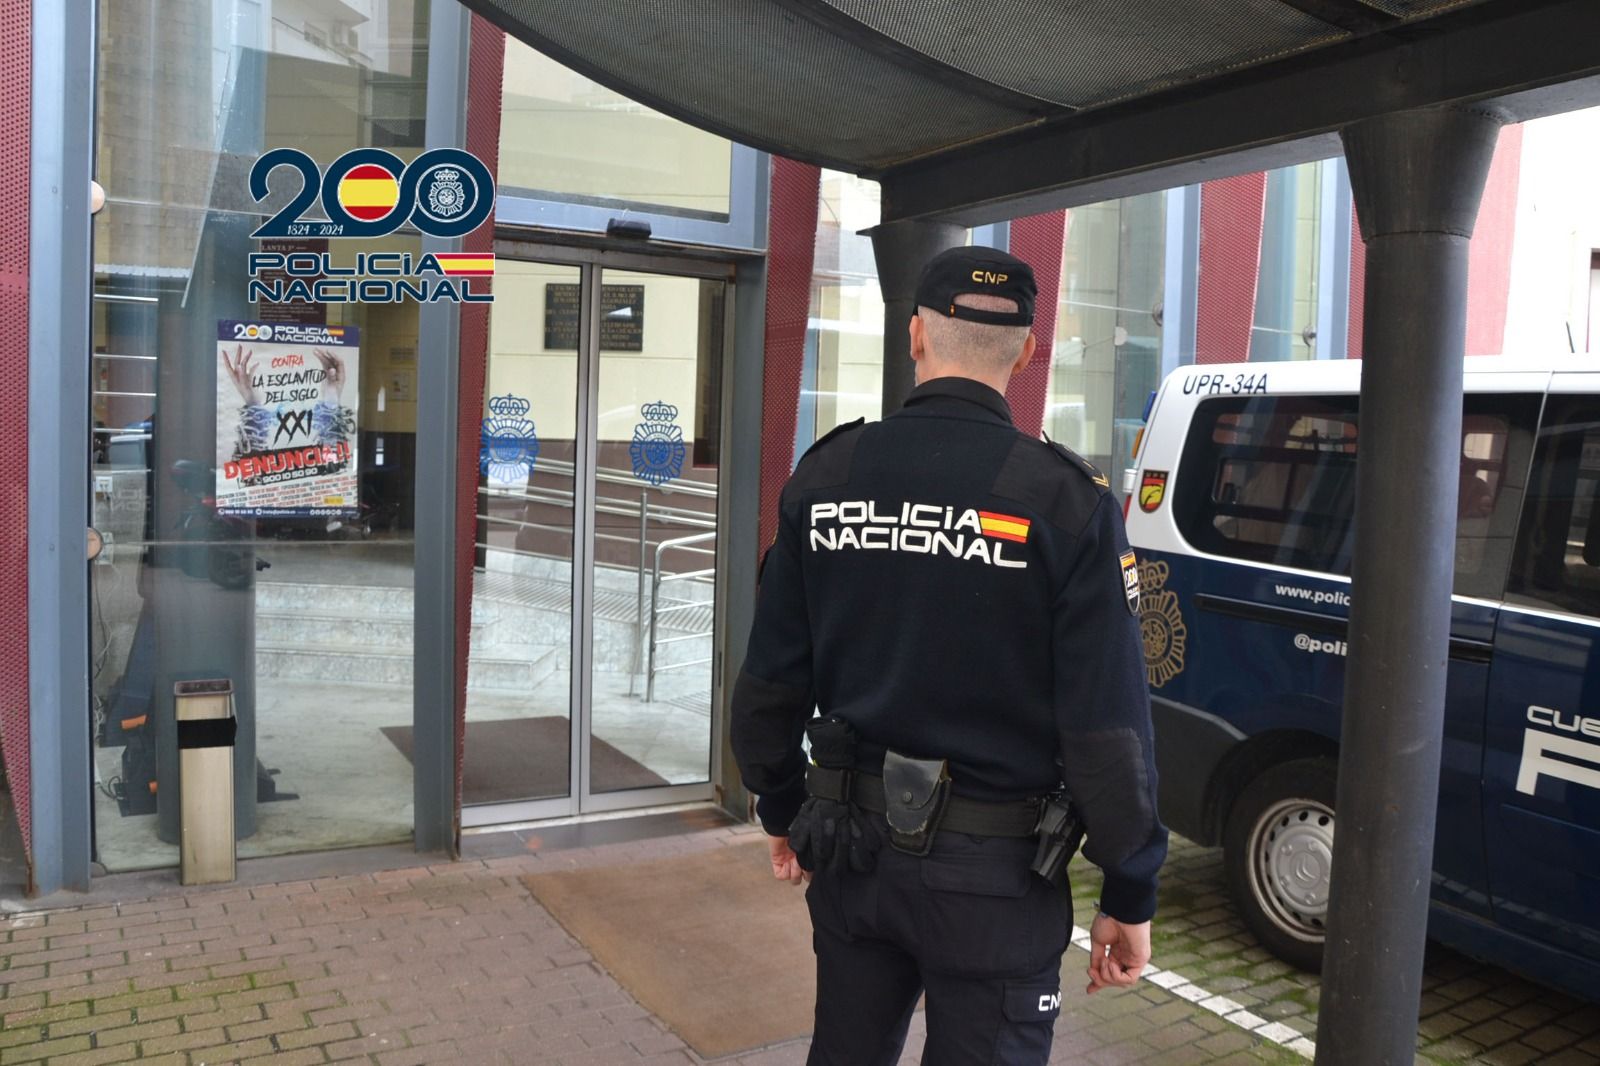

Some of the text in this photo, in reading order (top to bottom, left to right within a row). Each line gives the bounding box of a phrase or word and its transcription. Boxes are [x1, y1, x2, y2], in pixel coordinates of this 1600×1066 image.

[971, 270, 1008, 285] CNP
[234, 324, 272, 340] 200
[275, 334, 344, 344] NACIONAL
[271, 354, 305, 369] CONTRA
[252, 369, 327, 388] LA ESCLAVITUD
[1183, 373, 1267, 395] UPR-34A
[264, 388, 319, 404] DEL SIGLO
[273, 409, 313, 448] XXI
[810, 527, 1028, 568] NACIONAL
[1275, 585, 1351, 606] www.polic
[1294, 633, 1347, 656] @poli
